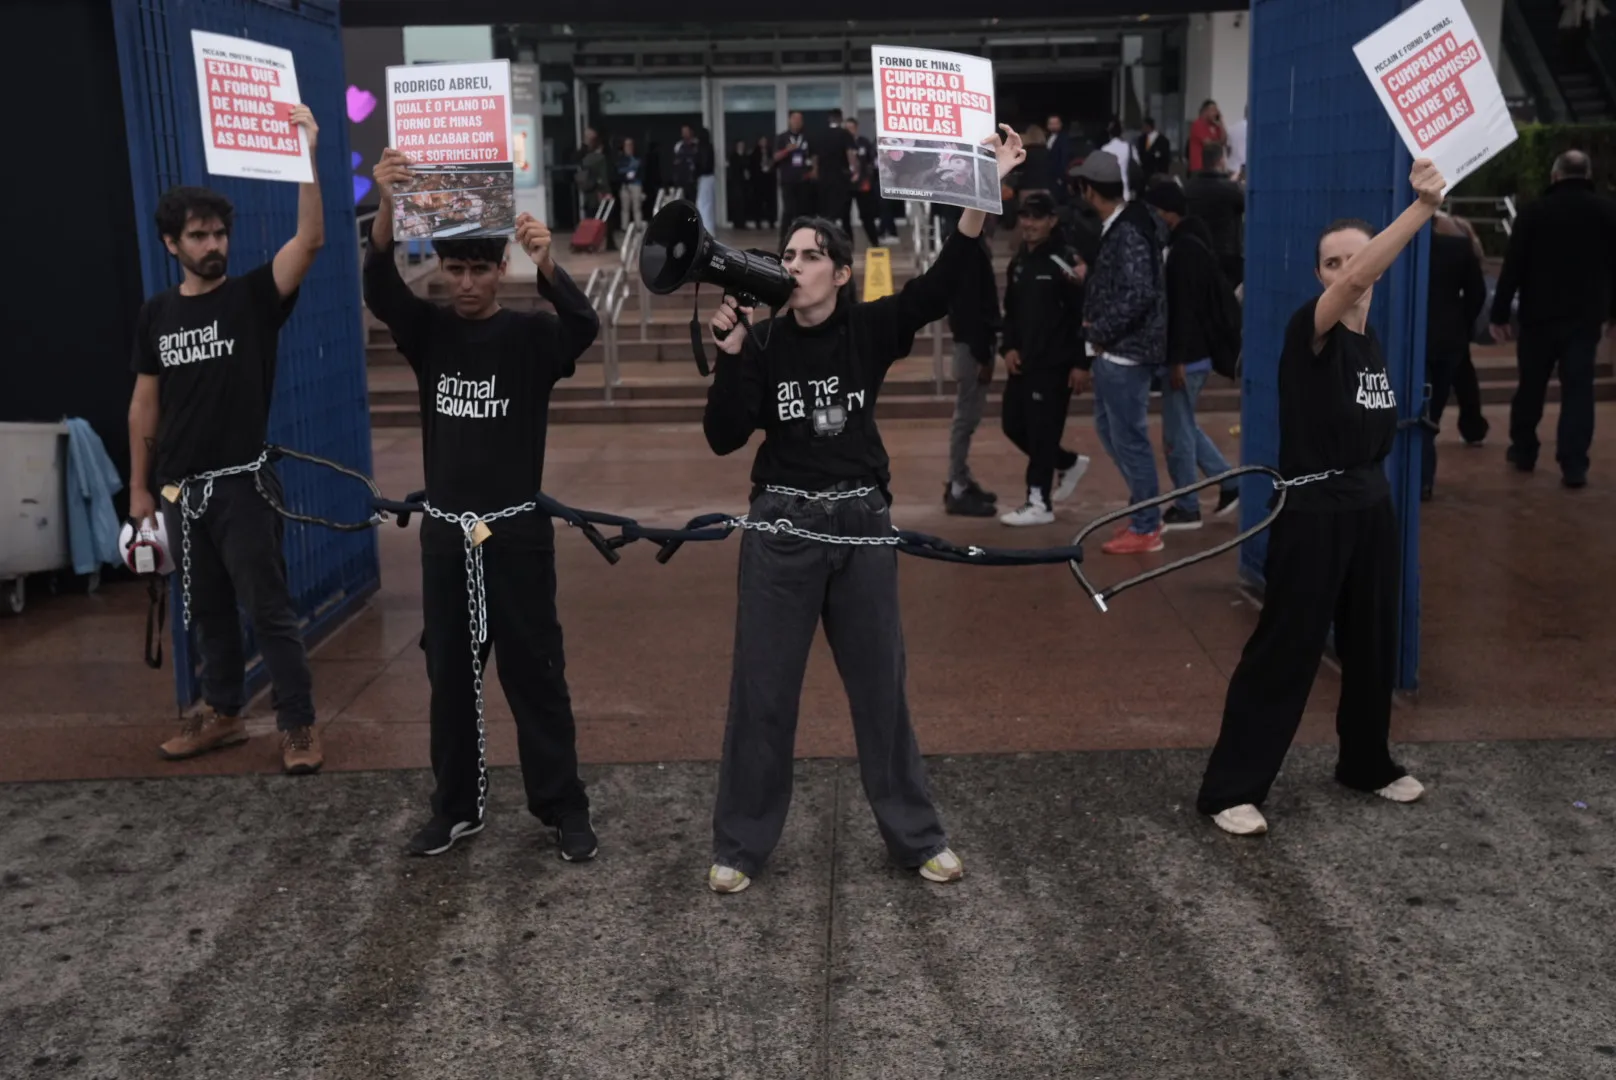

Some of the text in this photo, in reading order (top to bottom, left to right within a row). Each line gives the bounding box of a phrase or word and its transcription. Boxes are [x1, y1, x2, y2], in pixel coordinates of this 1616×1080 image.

[1375, 53, 1398, 73] MCCAIN
[1404, 36, 1423, 53] FORNO
[1423, 30, 1432, 40] DE
[209, 61, 276, 83] EXIJA QUE
[880, 56, 961, 72] FORNO DE MINAS
[1387, 37, 1457, 92] CUMPRAM O
[394, 76, 492, 93] RODRIGO ABREU,
[885, 70, 959, 88] CUMPRA O
[1397, 46, 1478, 108] COMPROMISSO
[211, 79, 267, 97] A FORNO
[886, 86, 988, 110] COMPROMISSO
[213, 96, 275, 115] DE MINAS
[397, 99, 495, 115] QUAL É O PLANO DA
[887, 100, 953, 119] LIVRE DE
[1407, 82, 1460, 126] LIVRE DE
[215, 114, 290, 134] ACABE COM
[397, 116, 482, 130] FORNO DE MINAS
[888, 116, 957, 134] GAIOLAS!
[1417, 100, 1469, 142] GAIOLAS!
[217, 132, 298, 152] AS GAIOLAS!
[398, 132, 494, 146] PARA ACABAR COM
[404, 148, 499, 162] SSE SOFRIMENTO?
[159, 320, 218, 351] animal
[161, 338, 234, 367] EQUALITY
[437, 371, 495, 399] animal
[437, 393, 510, 418] EQUALITY
